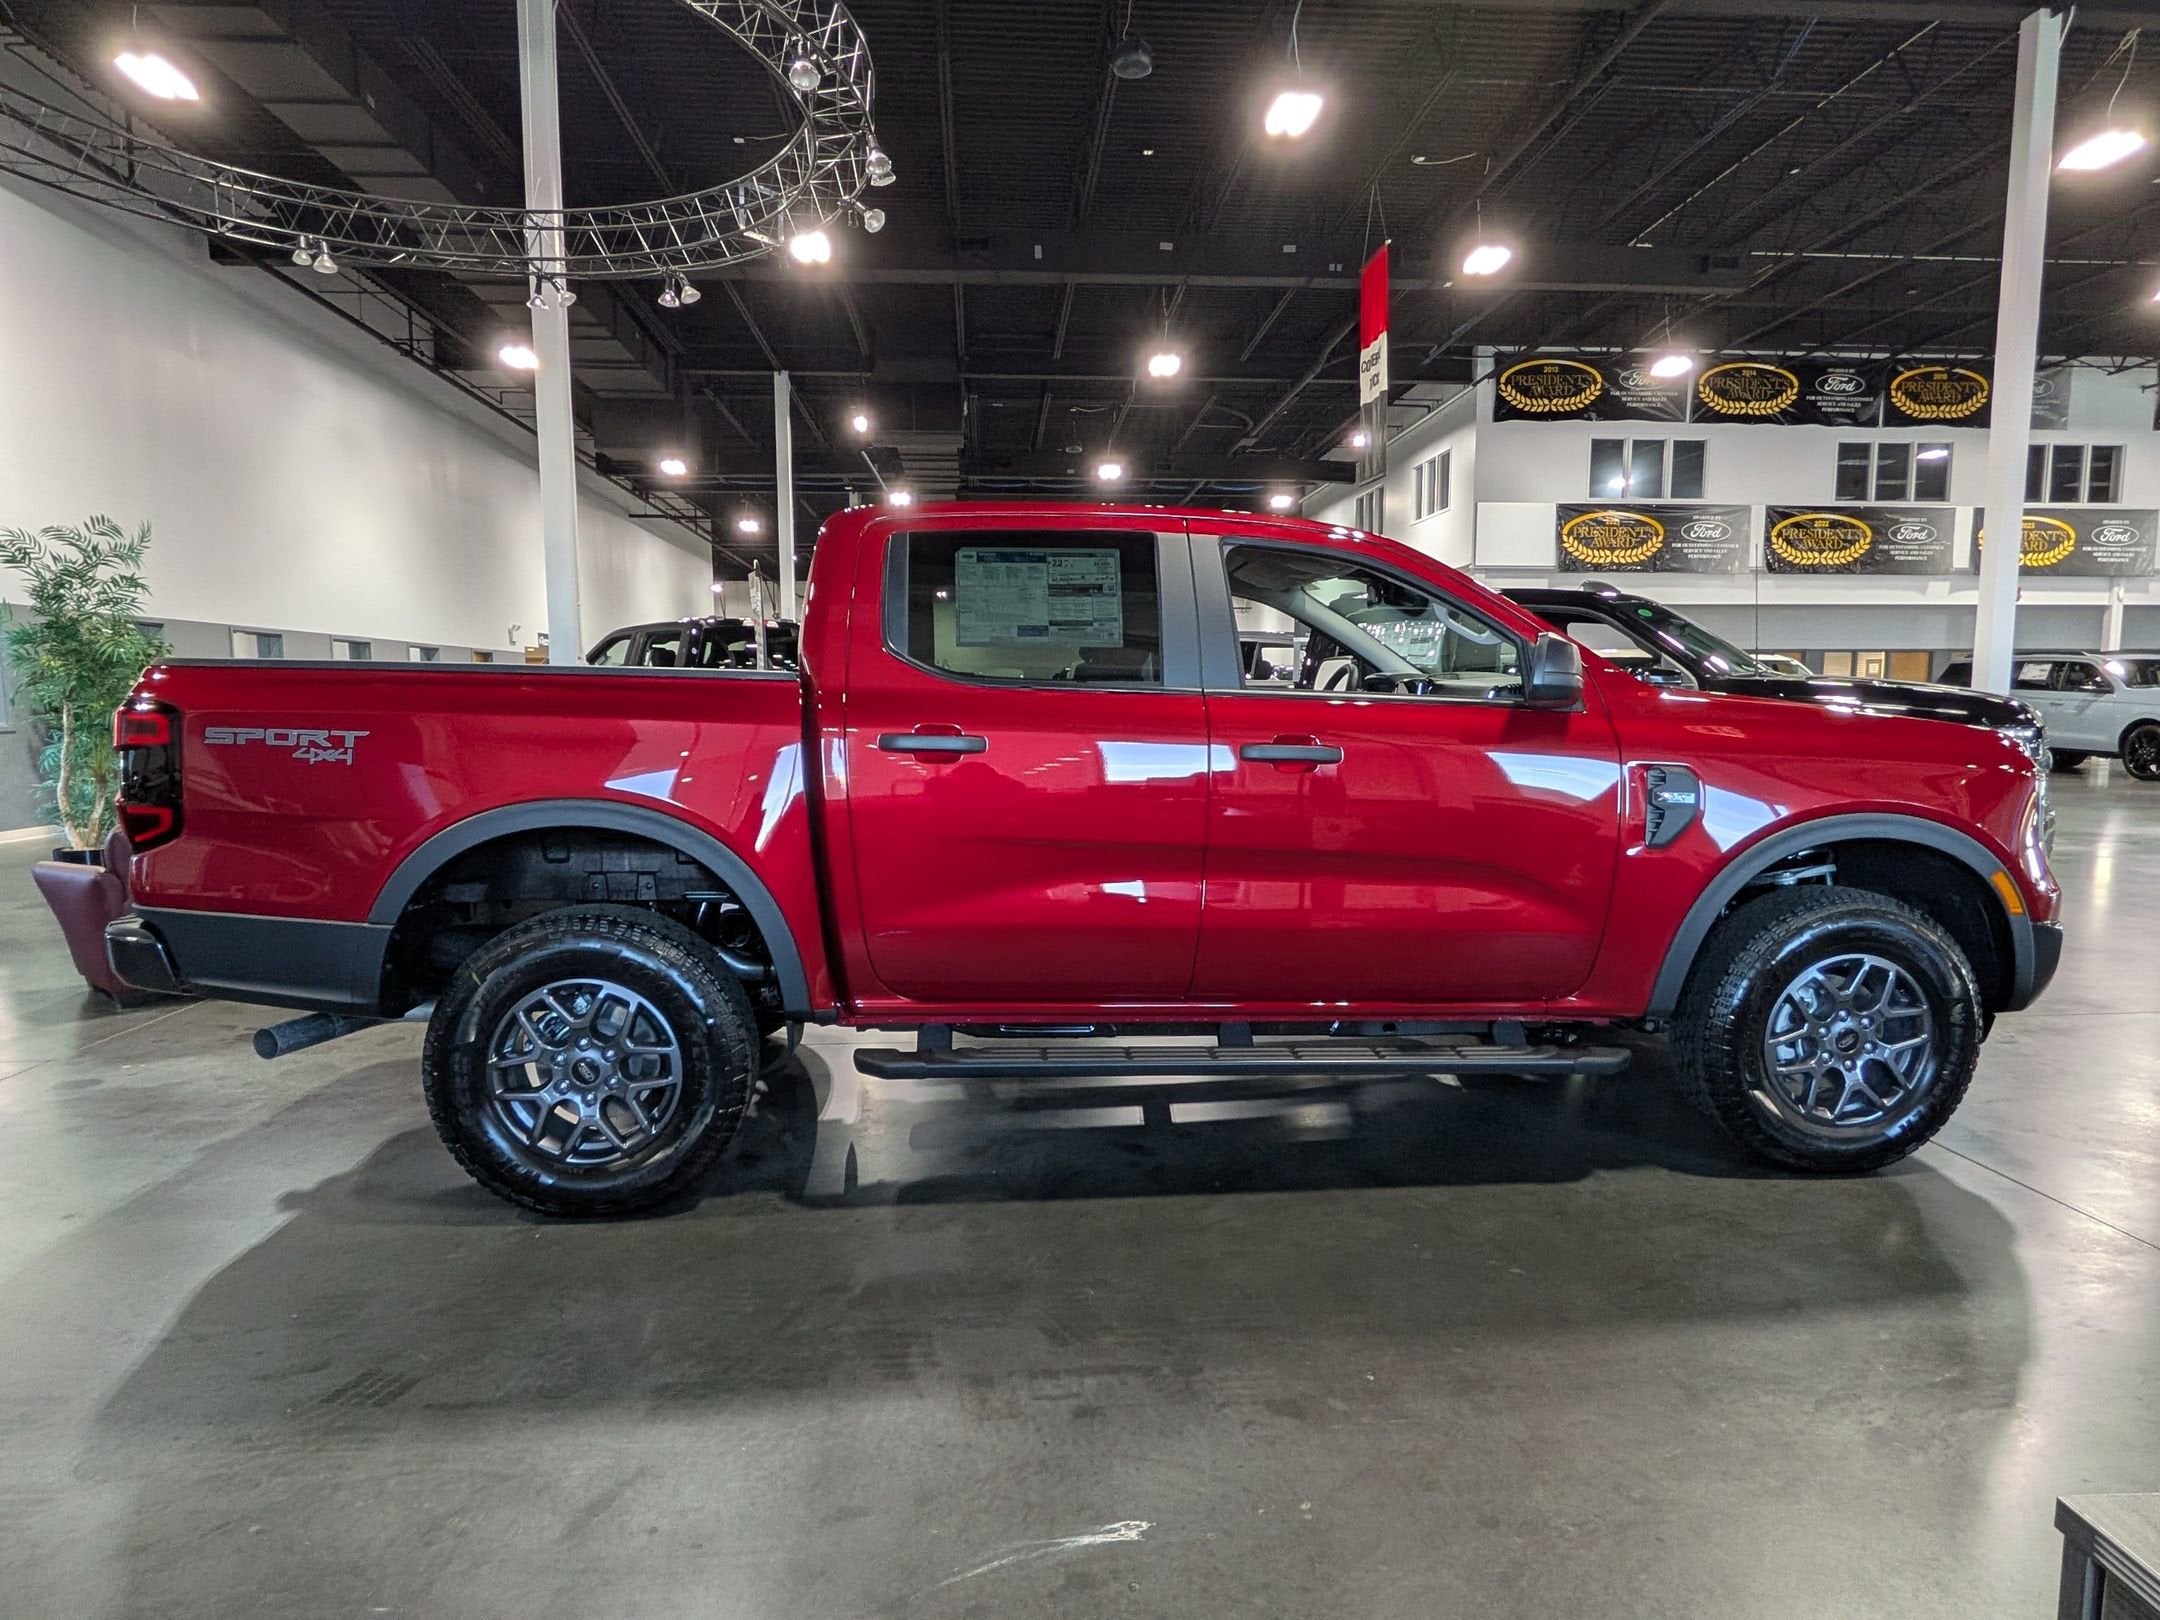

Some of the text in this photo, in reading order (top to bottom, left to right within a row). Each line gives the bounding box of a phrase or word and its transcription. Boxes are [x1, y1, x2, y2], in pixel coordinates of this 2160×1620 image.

[1511, 374, 1594, 387] PRESIDENT'S
[1710, 376, 1790, 390] PRESIDENT'S
[1824, 376, 1856, 391] Ford
[1529, 385, 1575, 397] AWARD
[1901, 381, 1981, 393] PRESIDENT'S
[1727, 388, 1773, 400] AWARD
[1918, 390, 1962, 402] AWARD
[1573, 526, 1656, 538] PRESIDENT'S
[1690, 523, 1722, 538] Ford
[1781, 527, 1863, 540] PRESIDENT'S
[1896, 525, 1928, 540] Ford
[2023, 530, 2068, 542] DENT'S
[2100, 528, 2131, 542] Ford
[1590, 537, 1636, 548] AWARD
[1801, 538, 1844, 550] AWARD
[2021, 540, 2049, 552] ARD
[203, 726, 371, 748] SPORT
